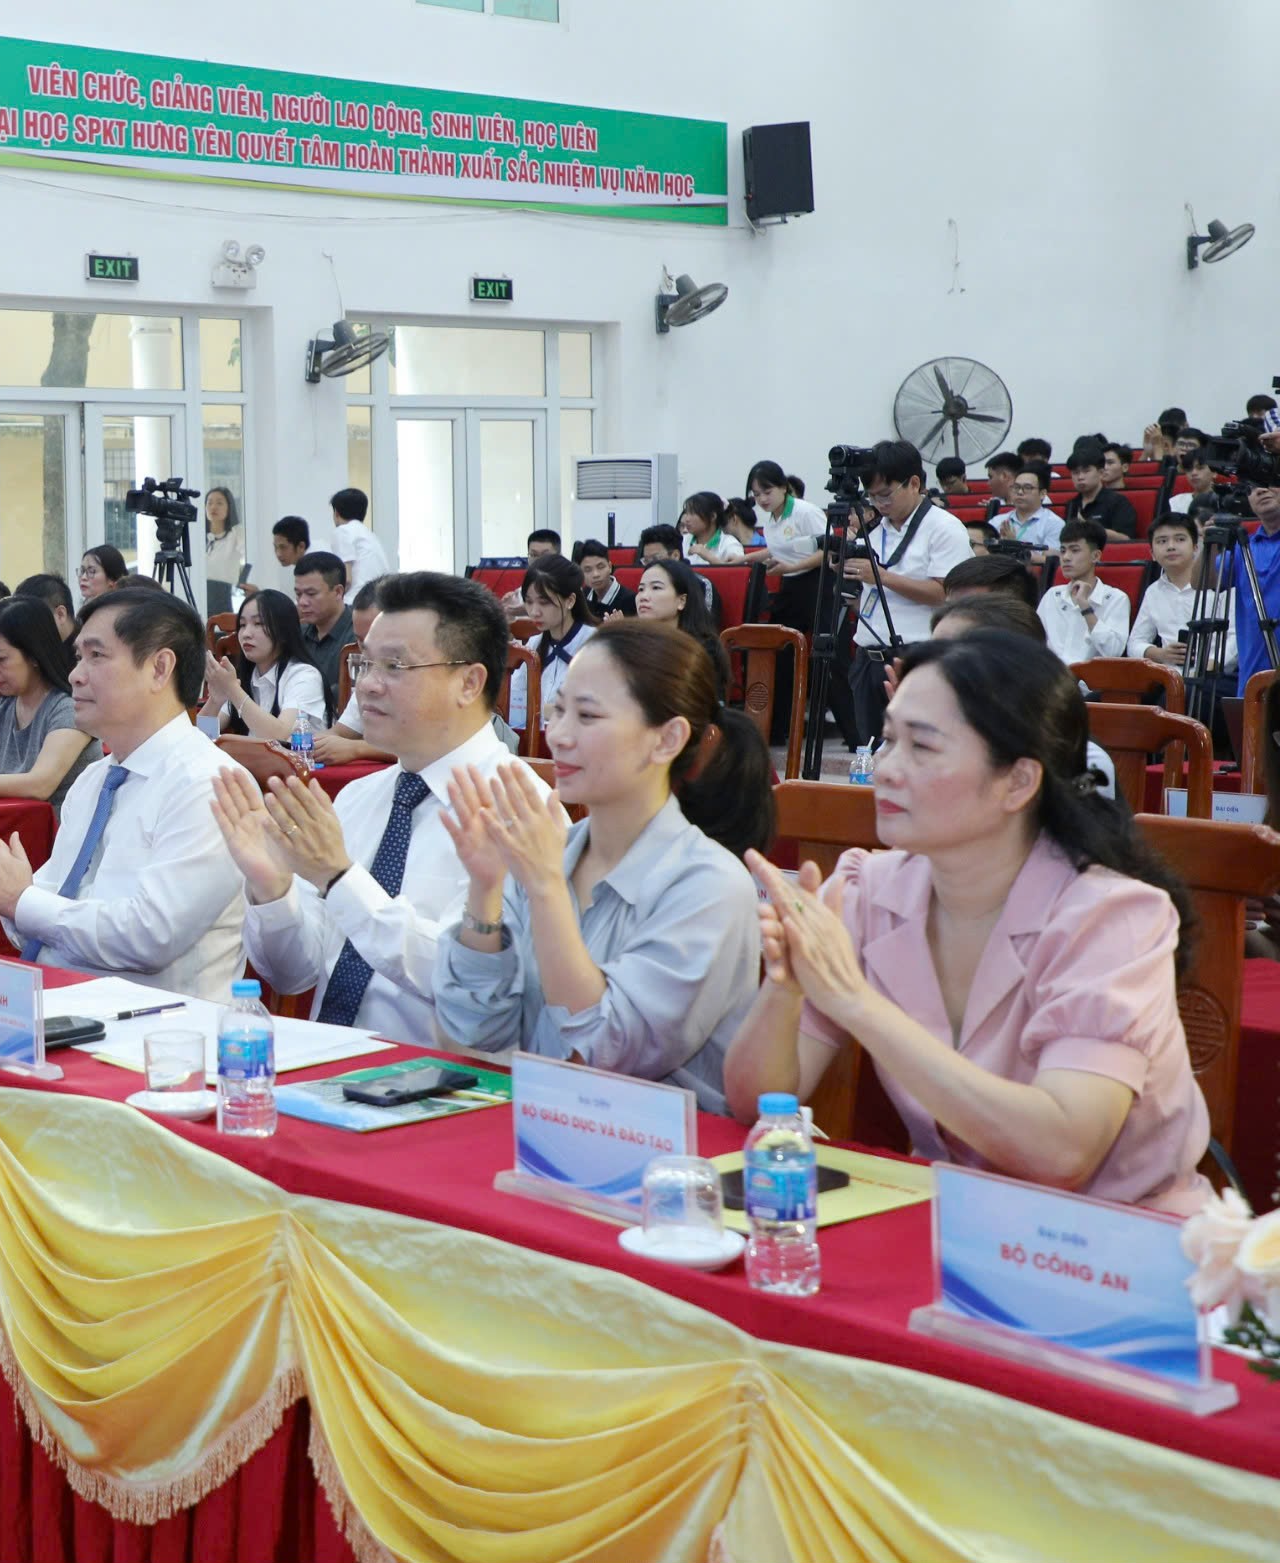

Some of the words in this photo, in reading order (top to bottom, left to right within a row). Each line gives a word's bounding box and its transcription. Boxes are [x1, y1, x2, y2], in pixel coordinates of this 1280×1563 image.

[28, 63, 77, 98] VIÊN
[84, 70, 145, 108] CHỨC,
[152, 74, 212, 112] GIẢNG
[218, 84, 267, 121] VIÊN,
[273, 93, 330, 126] NGƯỜI
[335, 101, 369, 129] LAO
[373, 101, 426, 138] ĐỘNG,
[432, 112, 472, 139] SINH
[477, 112, 519, 147] VIÊN,
[524, 121, 557, 151] HỌC
[561, 121, 597, 151] VIÊN
[24, 109, 67, 146] HỌC
[74, 116, 127, 146] SPKT
[132, 120, 187, 152] HƯNG
[193, 123, 231, 158] YÊN
[237, 128, 296, 162] QUYẾT
[300, 135, 340, 168] TÂM
[346, 141, 394, 171] HOÀN
[398, 145, 455, 177] THÀNH
[460, 148, 502, 181] XUẤT
[507, 151, 540, 183] SẮC
[545, 160, 595, 192] NHIỆM
[600, 166, 619, 195] VỤ
[625, 165, 659, 194] NĂM
[664, 173, 694, 201] HỌC
[95, 258, 132, 277] EXIT
[478, 281, 507, 297] EXIT
[1000, 1242, 1027, 1269] BỘ
[1032, 1252, 1095, 1283] CÔNG
[1100, 1270, 1129, 1292] AN
